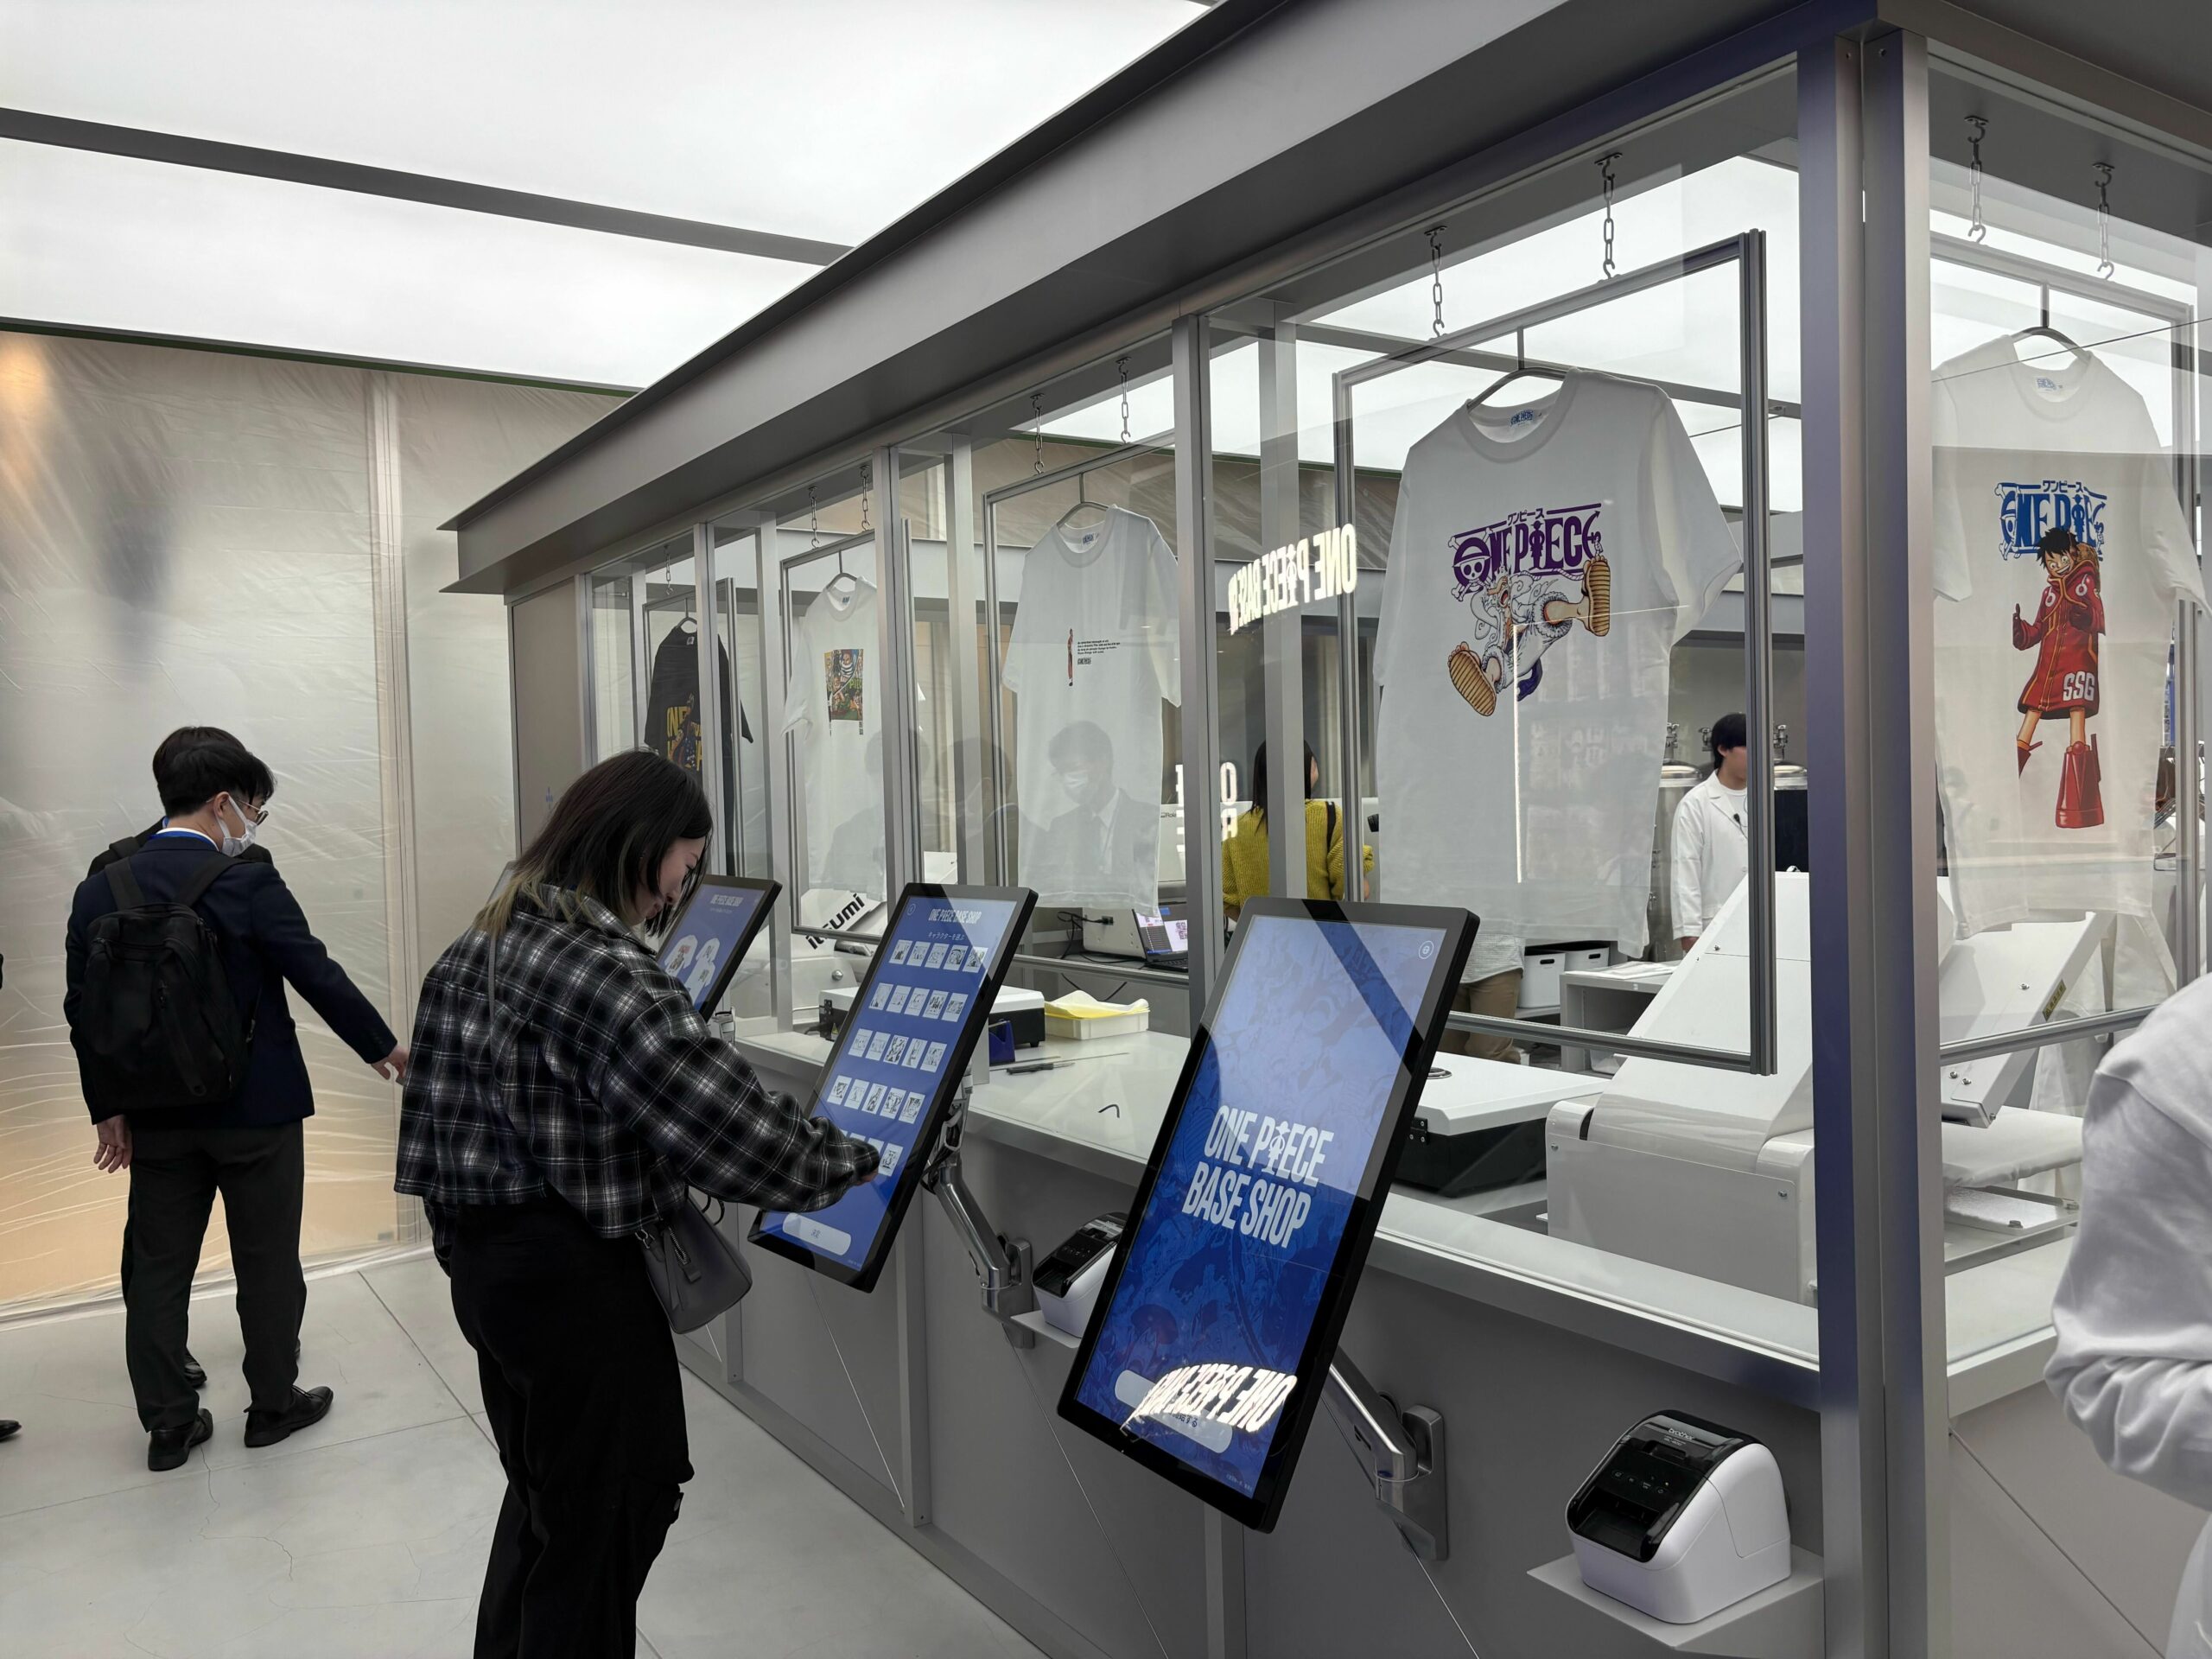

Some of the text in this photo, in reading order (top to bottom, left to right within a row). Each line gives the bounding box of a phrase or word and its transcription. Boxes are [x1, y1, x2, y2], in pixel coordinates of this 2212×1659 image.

[2063, 671, 2095, 702] SSG
[1205, 1105, 1334, 1187] ONE PIECE
[1182, 1161, 1312, 1249] BASE SHOP
